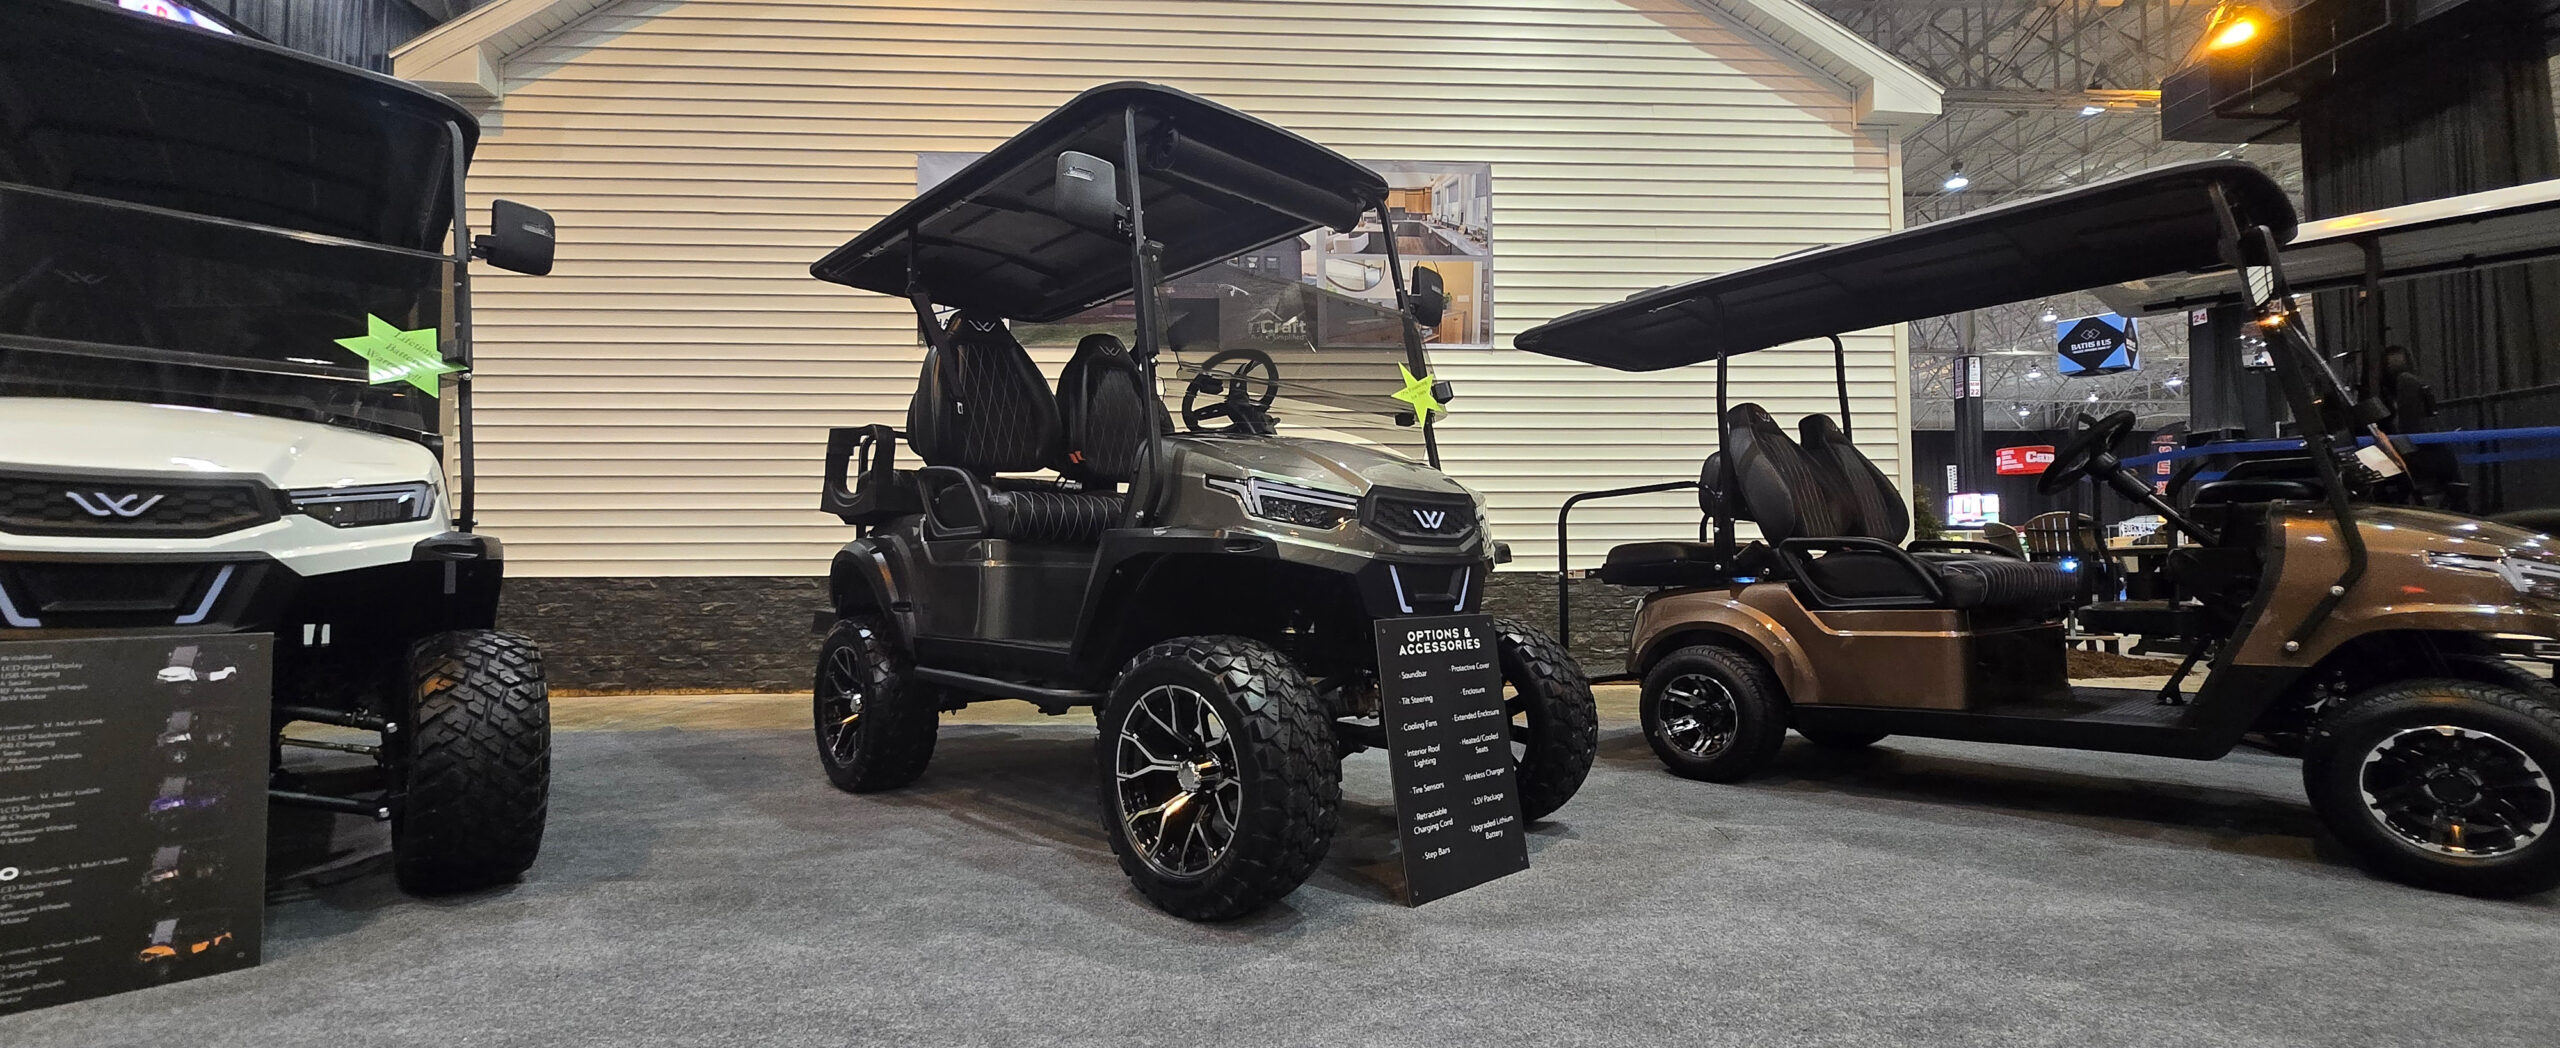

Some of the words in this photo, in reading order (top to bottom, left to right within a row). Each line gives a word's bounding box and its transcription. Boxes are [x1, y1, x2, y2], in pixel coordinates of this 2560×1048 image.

[2193, 313, 2206, 323] 24
[1407, 628, 1460, 642] OPTIONS
[1464, 627, 1471, 638] &
[1399, 638, 1481, 656] ACCESSORIES
[1451, 664, 1475, 672] Protective
[1476, 662, 1490, 670] Cover
[1401, 670, 1427, 680] Soundbar
[1462, 687, 1486, 696] Enclosure
[1402, 696, 1411, 705] Tilt
[1411, 695, 1434, 704] Steering
[1454, 710, 1477, 722] Extended
[1477, 708, 1500, 718] Enclosure
[1404, 721, 1425, 732] Cooling
[1426, 719, 1438, 728] Fans
[1462, 732, 1499, 746] Heated/Cooled
[1406, 747, 1427, 756] Interior
[1428, 744, 1440, 752] Roof
[1475, 746, 1488, 754] Seats
[1414, 757, 1437, 768] Lighting
[1464, 772, 1486, 782] Wireless
[1486, 767, 1505, 778] Charger
[1412, 786, 1423, 794] Tire
[1424, 782, 1444, 792] Sensors
[1474, 797, 1484, 806] LSV
[1484, 792, 1504, 803] Package
[1416, 808, 1448, 821] Retractable
[1414, 822, 1439, 835] Charging
[1440, 818, 1454, 828] Cord
[1470, 820, 1496, 832] Upgraded
[1496, 814, 1514, 826] Lithium
[1486, 829, 1504, 840] Battery
[1424, 850, 1438, 860] Step
[1438, 846, 1450, 856] Bars
